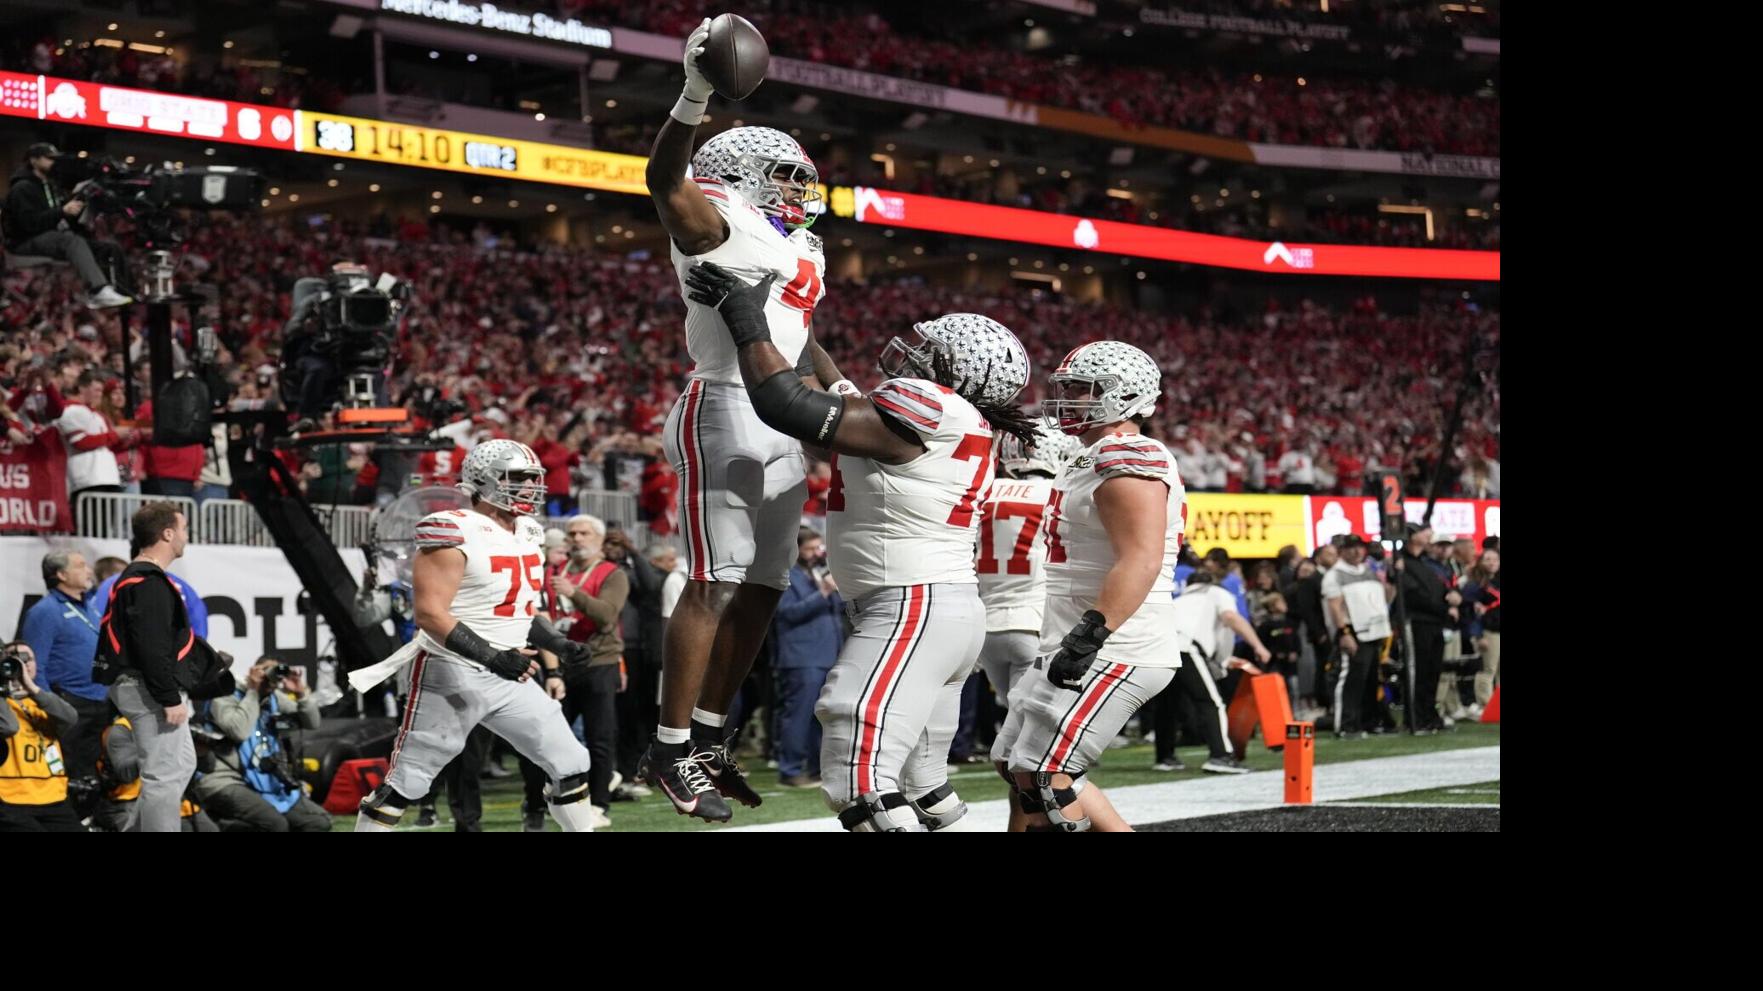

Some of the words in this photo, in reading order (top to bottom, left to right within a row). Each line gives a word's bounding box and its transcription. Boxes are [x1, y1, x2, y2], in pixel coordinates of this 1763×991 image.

[532, 13, 612, 48] Stadium
[368, 126, 451, 164] 14:10
[781, 257, 821, 328] 4
[995, 484, 1034, 499] TATE
[1383, 475, 1402, 515] 2
[978, 501, 1044, 575] 17
[1187, 511, 1274, 541] AYOFF
[489, 553, 543, 617] 75
